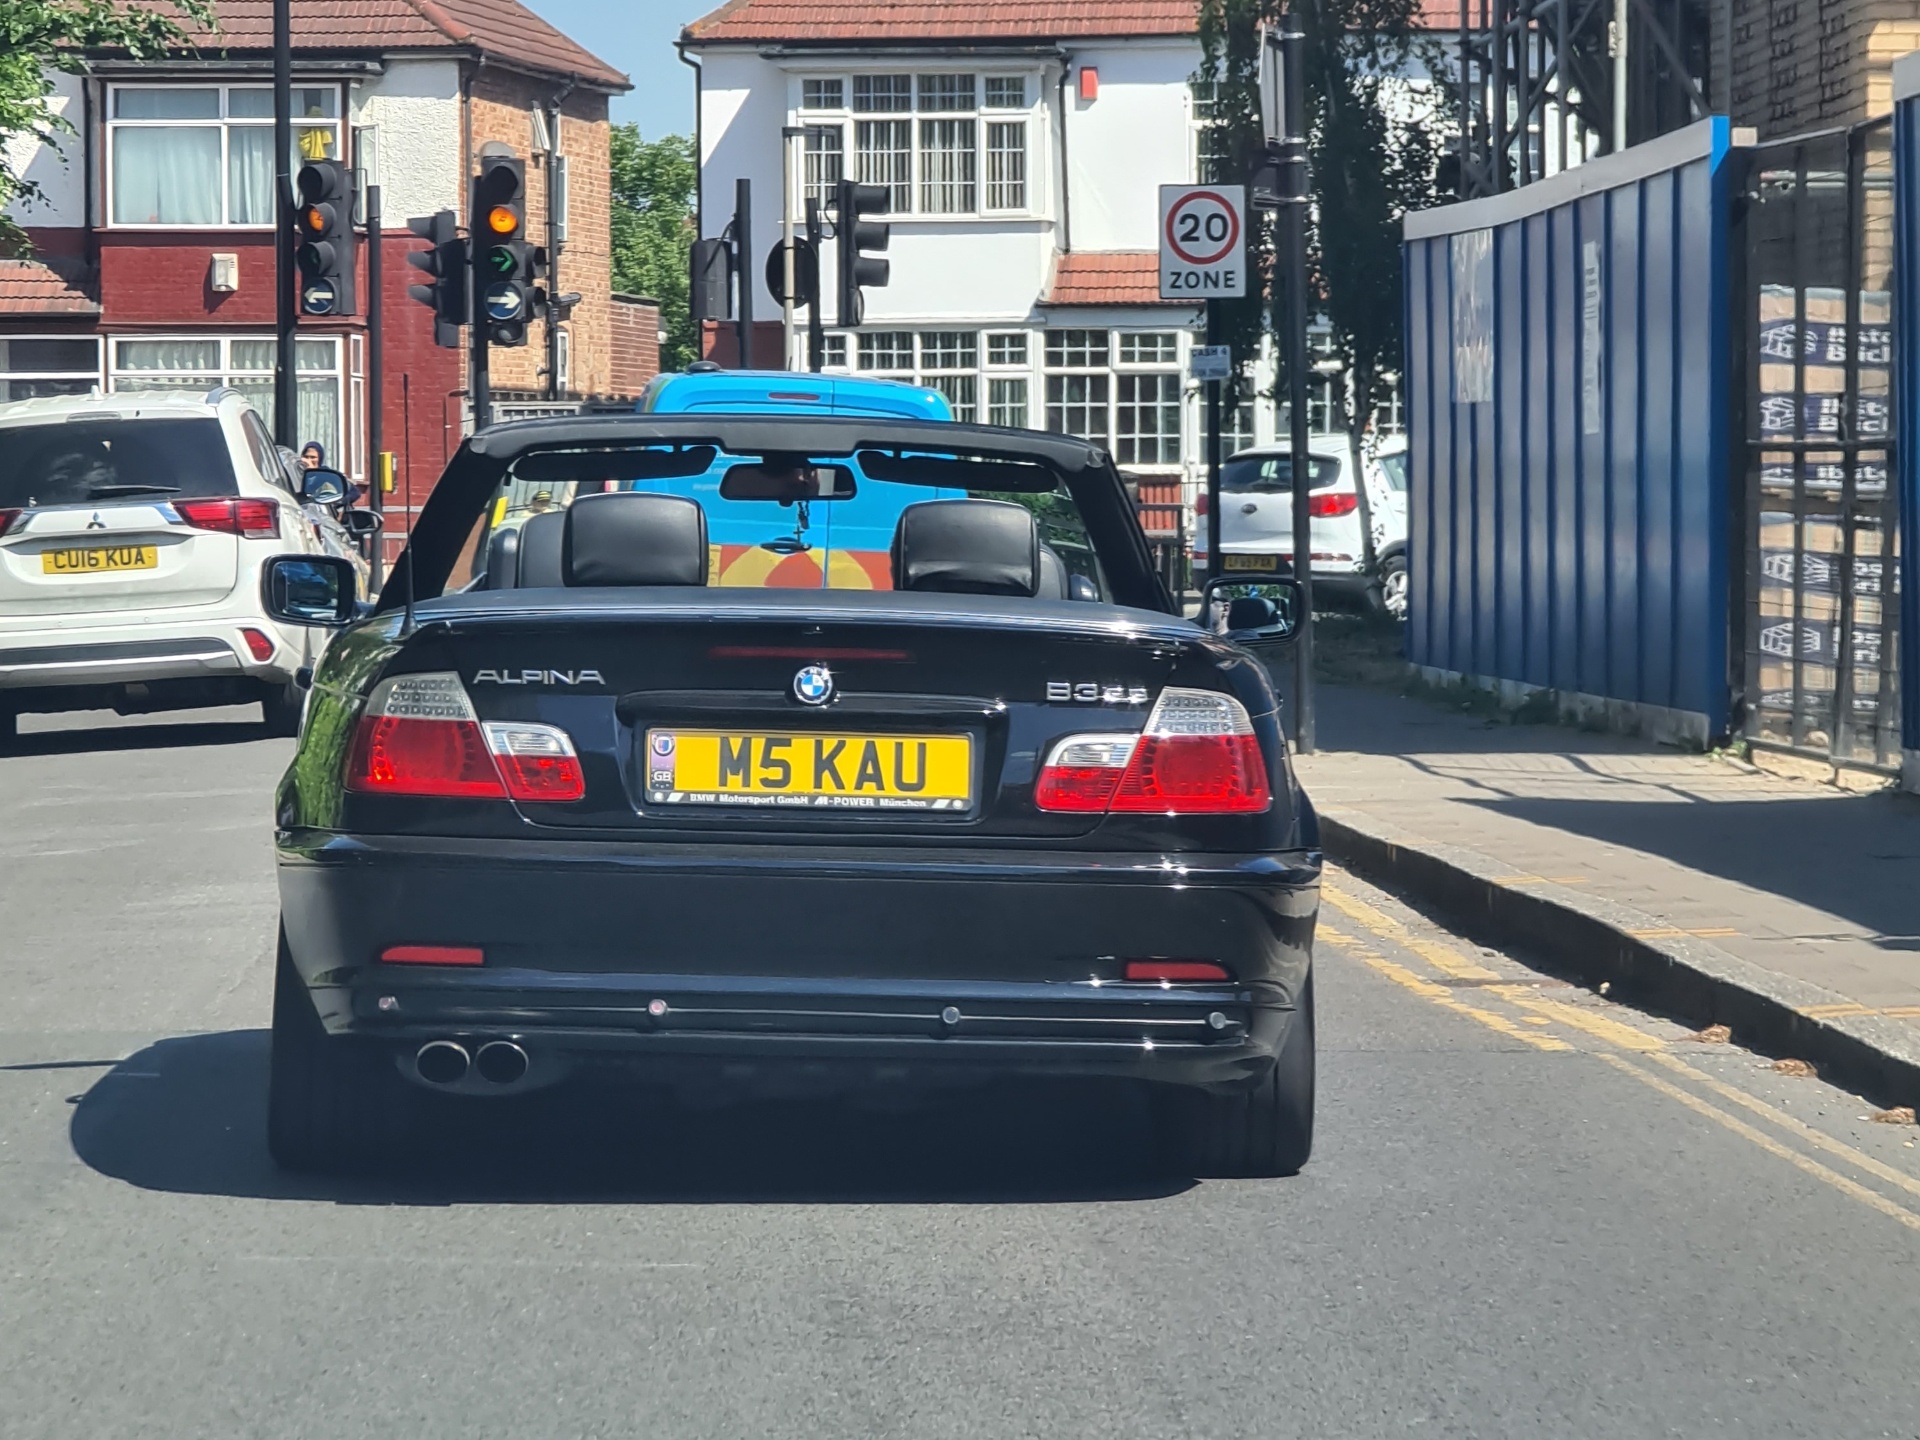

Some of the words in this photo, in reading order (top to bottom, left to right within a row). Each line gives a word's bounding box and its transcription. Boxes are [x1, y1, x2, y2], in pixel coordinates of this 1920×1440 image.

[1179, 213, 1228, 242] 20
[1169, 271, 1235, 289] ZONE
[54, 549, 100, 569] CU16
[105, 546, 146, 567] KUA
[472, 669, 606, 685] ALPINA
[718, 736, 792, 789] M5
[813, 738, 927, 792] KAU
[653, 770, 672, 782] GB
[689, 793, 716, 802] BMW
[719, 793, 775, 805] Motorsport
[777, 795, 809, 805] GmbH
[879, 797, 927, 807] München
